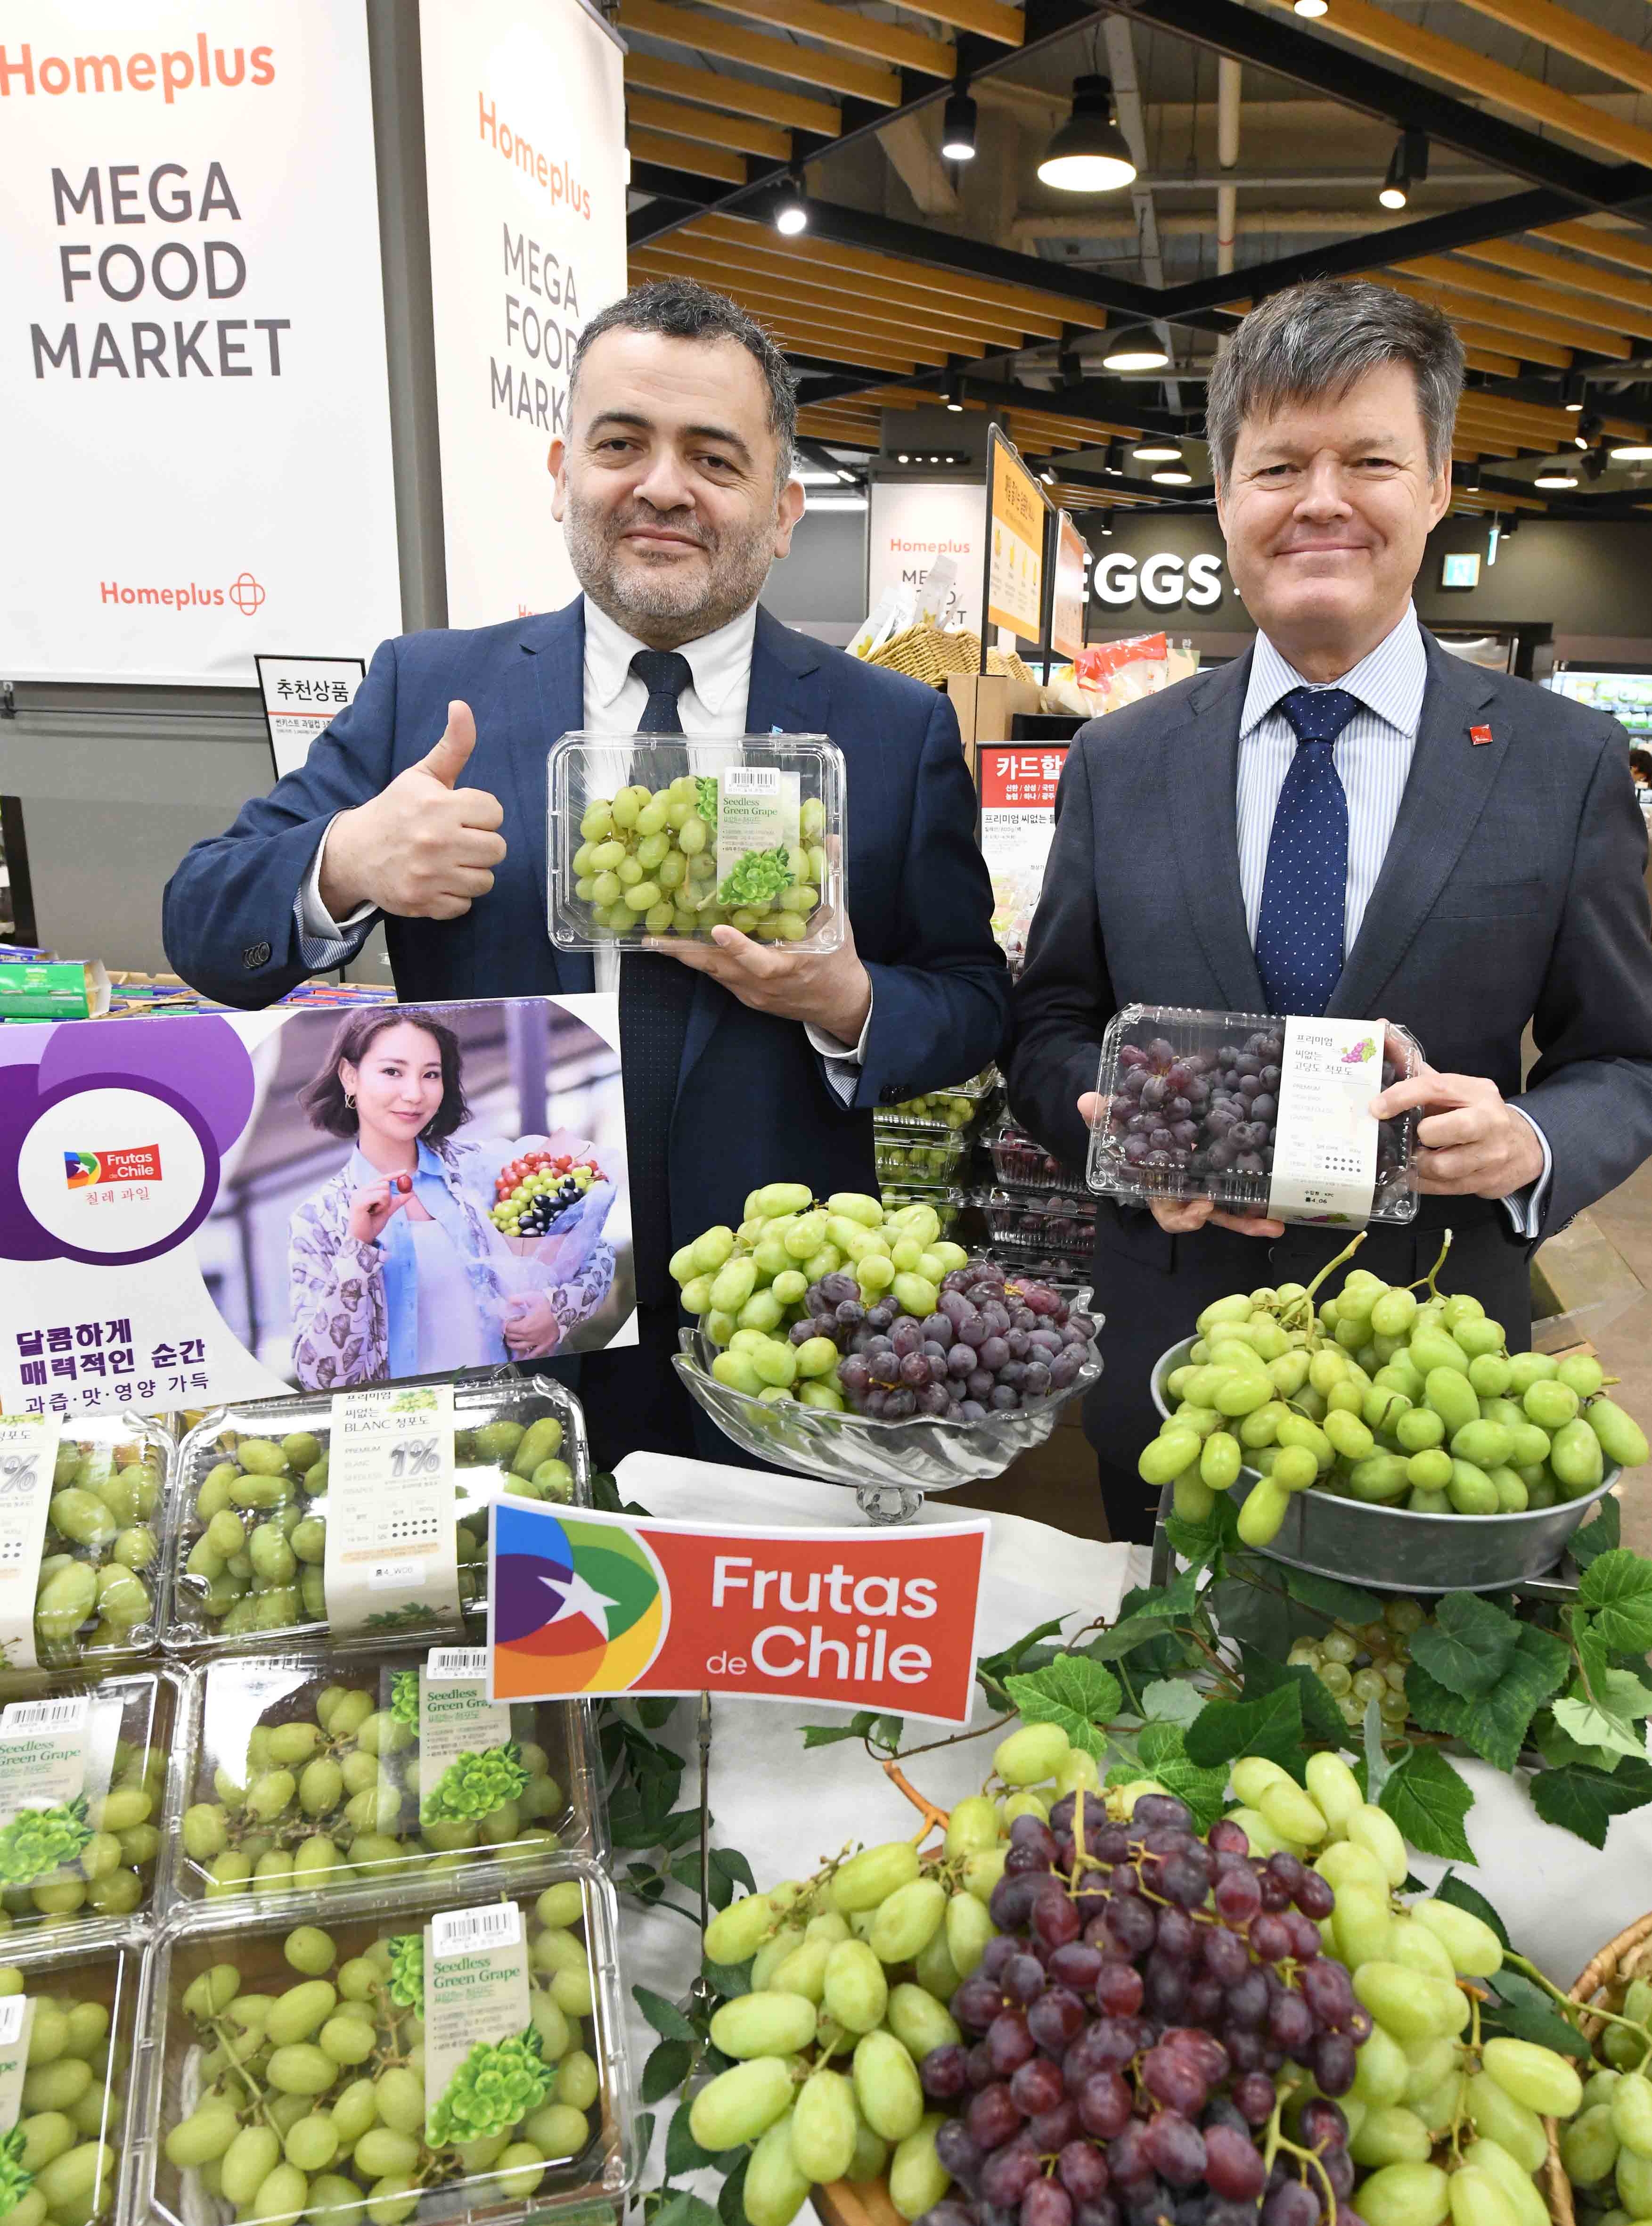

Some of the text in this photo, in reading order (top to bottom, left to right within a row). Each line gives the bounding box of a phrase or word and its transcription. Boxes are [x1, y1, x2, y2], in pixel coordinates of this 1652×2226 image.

[0, 33, 276, 104] Homeplus
[478, 90, 591, 221] Homeplus
[51, 161, 242, 226] MEGA
[59, 240, 247, 303] FOOD
[503, 222, 579, 318] MEGA
[29, 319, 291, 379] MARKET
[490, 356, 566, 434] MARK
[890, 539, 971, 554] Homeplus
[100, 581, 225, 611] Homeplus
[277, 679, 349, 703] 추천상품
[996, 755, 1066, 780] 카드할
[723, 797, 760, 806] Seedless
[723, 806, 777, 817] Green Grape
[985, 814, 1019, 824] 프리미엄
[1021, 814, 1047, 824] 씨없는
[1296, 1034, 1333, 1047] 프리미엄
[1295, 1049, 1323, 1060] 씨없는
[107, 1153, 153, 1166] Frutas
[117, 1165, 155, 1178] Chile
[86, 1187, 150, 1205] 칠레 과일
[16, 1318, 132, 1357] 달콤하게
[20, 1339, 205, 1386] 매력적인 순간
[168, 1372, 209, 1393] 가득
[346, 1391, 391, 1402] 프리미엄
[344, 1407, 379, 1419] 씨없는
[344, 1419, 391, 1432] BLANC
[712, 1555, 938, 1619] Frutas
[706, 1624, 932, 1684] de Chile
[427, 1688, 477, 1702] Seedless
[427, 1702, 464, 1712] Green
[41, 1749, 81, 1760] Grape
[433, 1957, 491, 1974] Seedless
[433, 1967, 520, 1989] Green Grape
